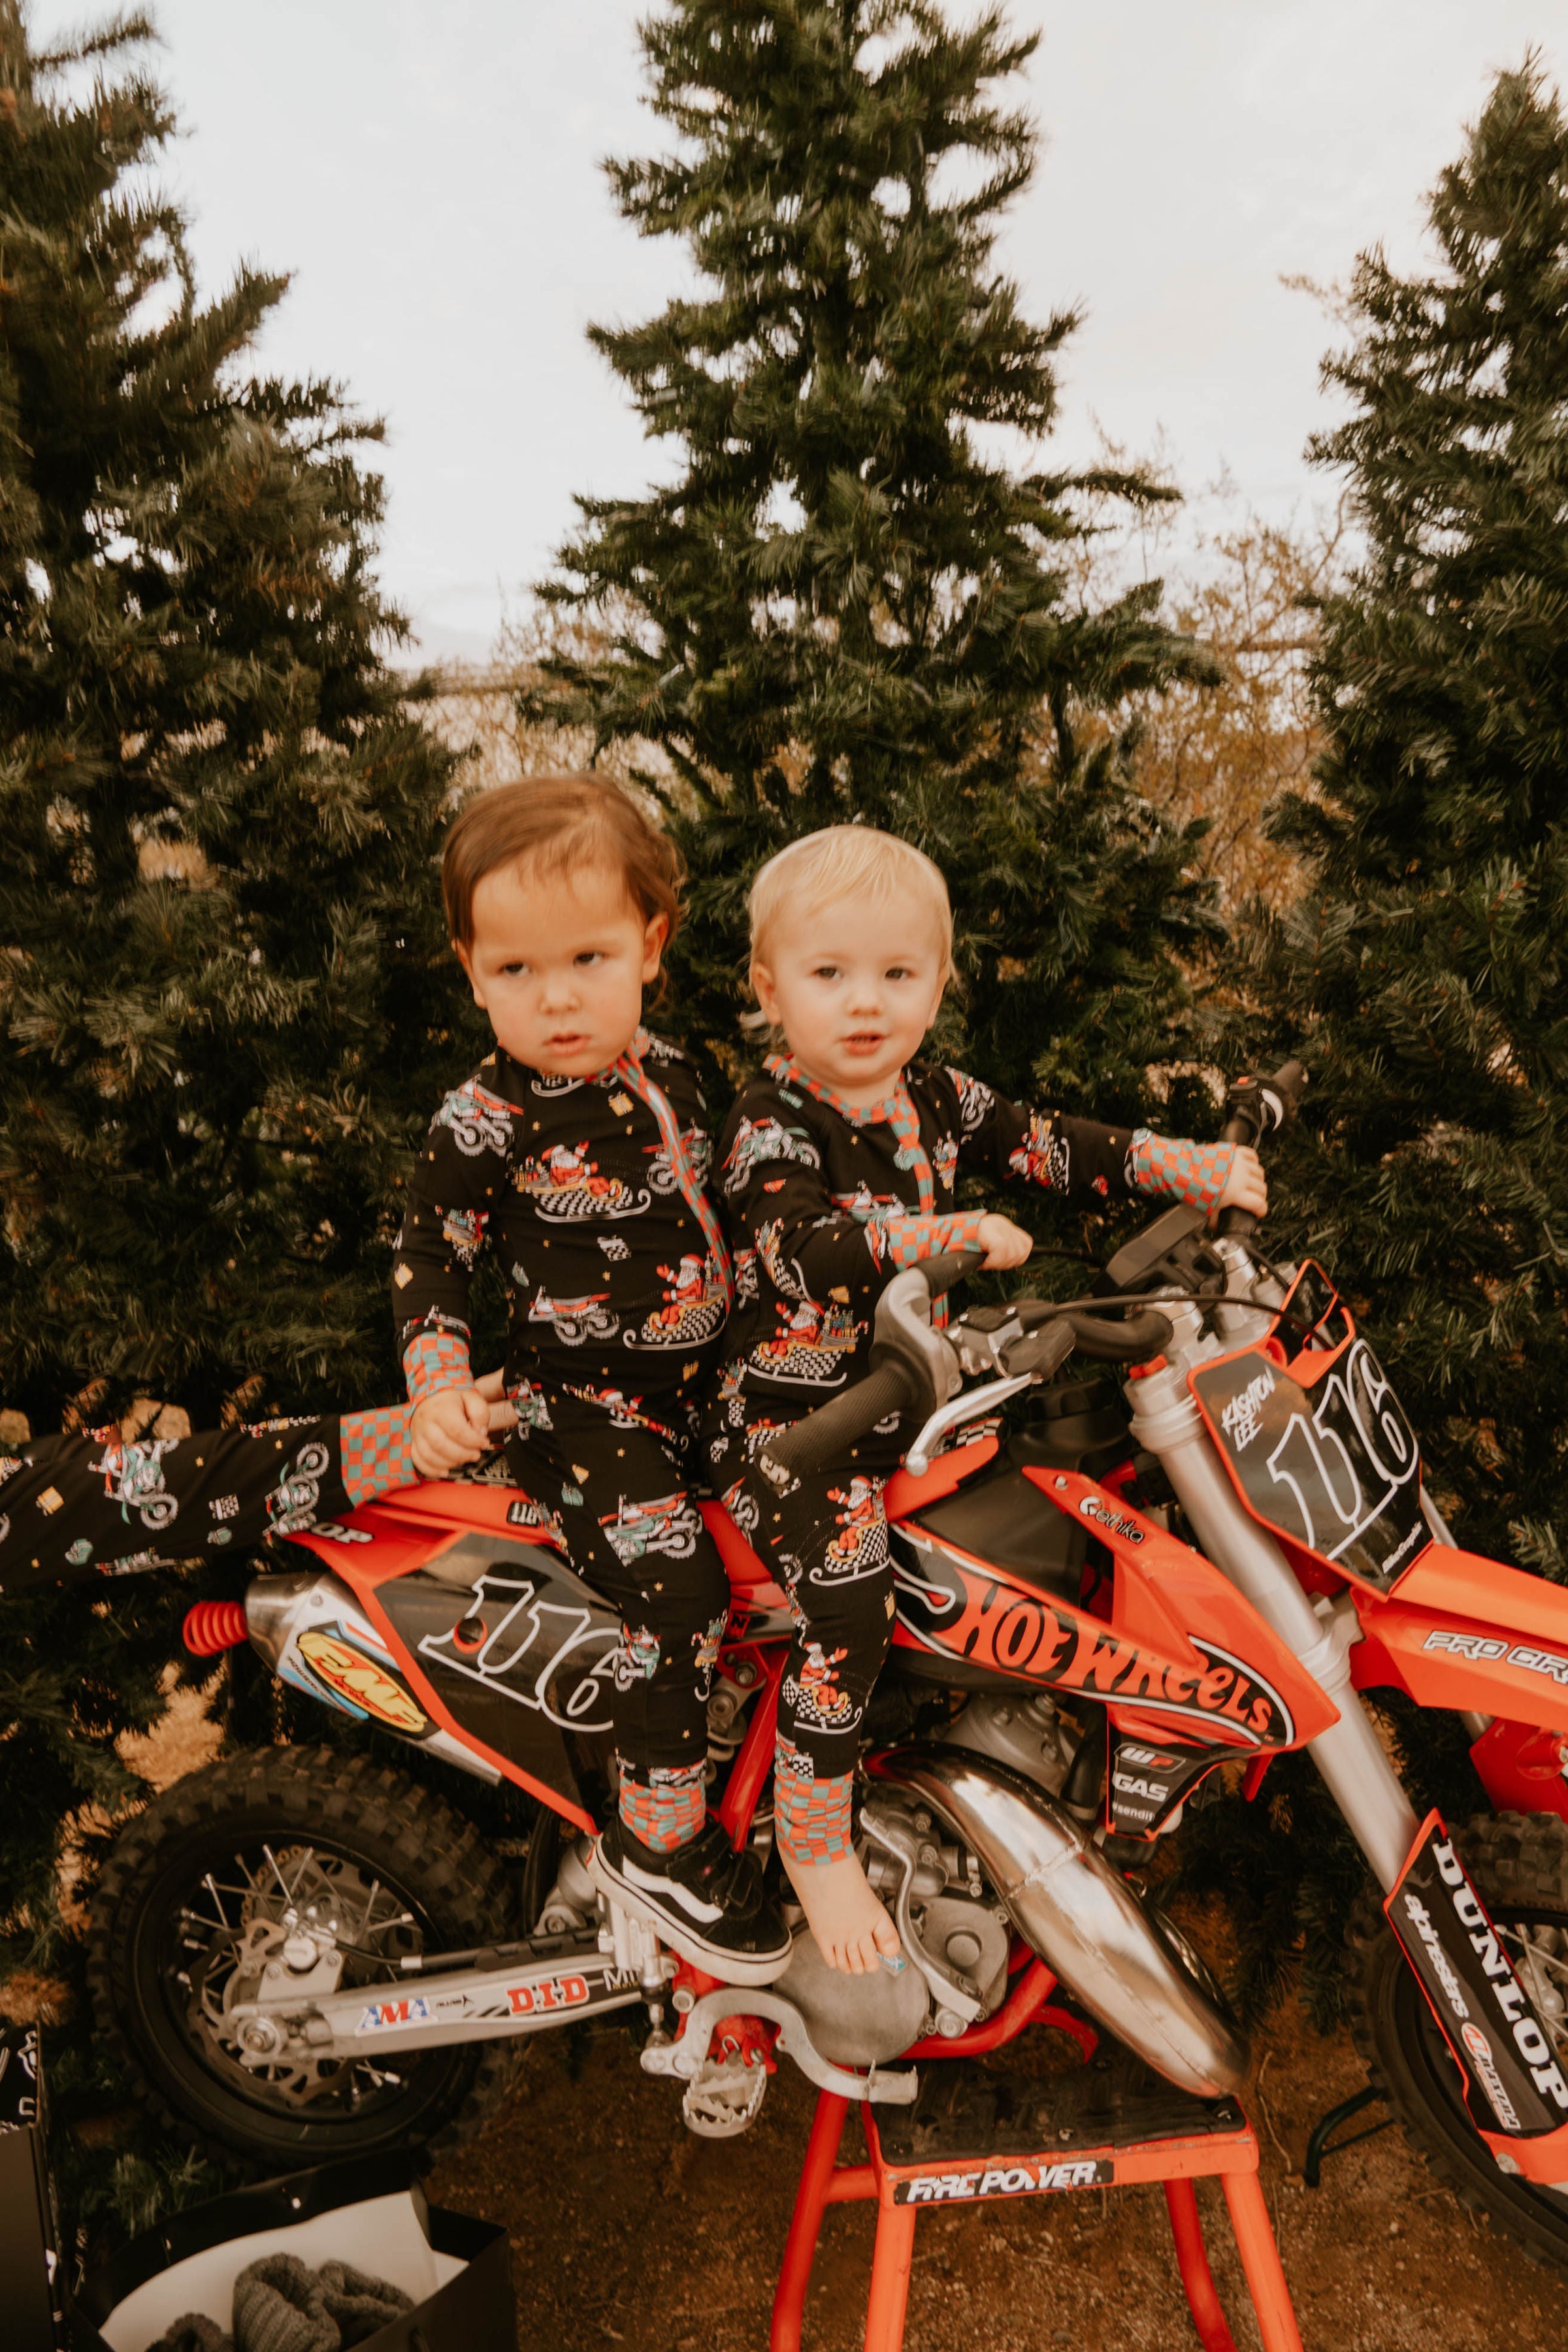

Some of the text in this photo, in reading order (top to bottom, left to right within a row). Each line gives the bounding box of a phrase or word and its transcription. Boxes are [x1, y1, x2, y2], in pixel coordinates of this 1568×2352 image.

[1221, 1364, 1276, 1437] KASHTON
[1234, 1411, 1264, 1452] LEE
[1266, 1337, 1419, 1561] 116
[298, 1635, 429, 1727] FMF
[417, 1575, 621, 1732] 116
[1422, 1629, 1509, 1661] PRO
[1111, 1771, 1169, 1803] GAS
[1120, 1746, 1174, 1767] WP
[1403, 1893, 1469, 2019] alpinestars
[1431, 1837, 1568, 2110] DUNLOP
[359, 1997, 431, 2030] AMA
